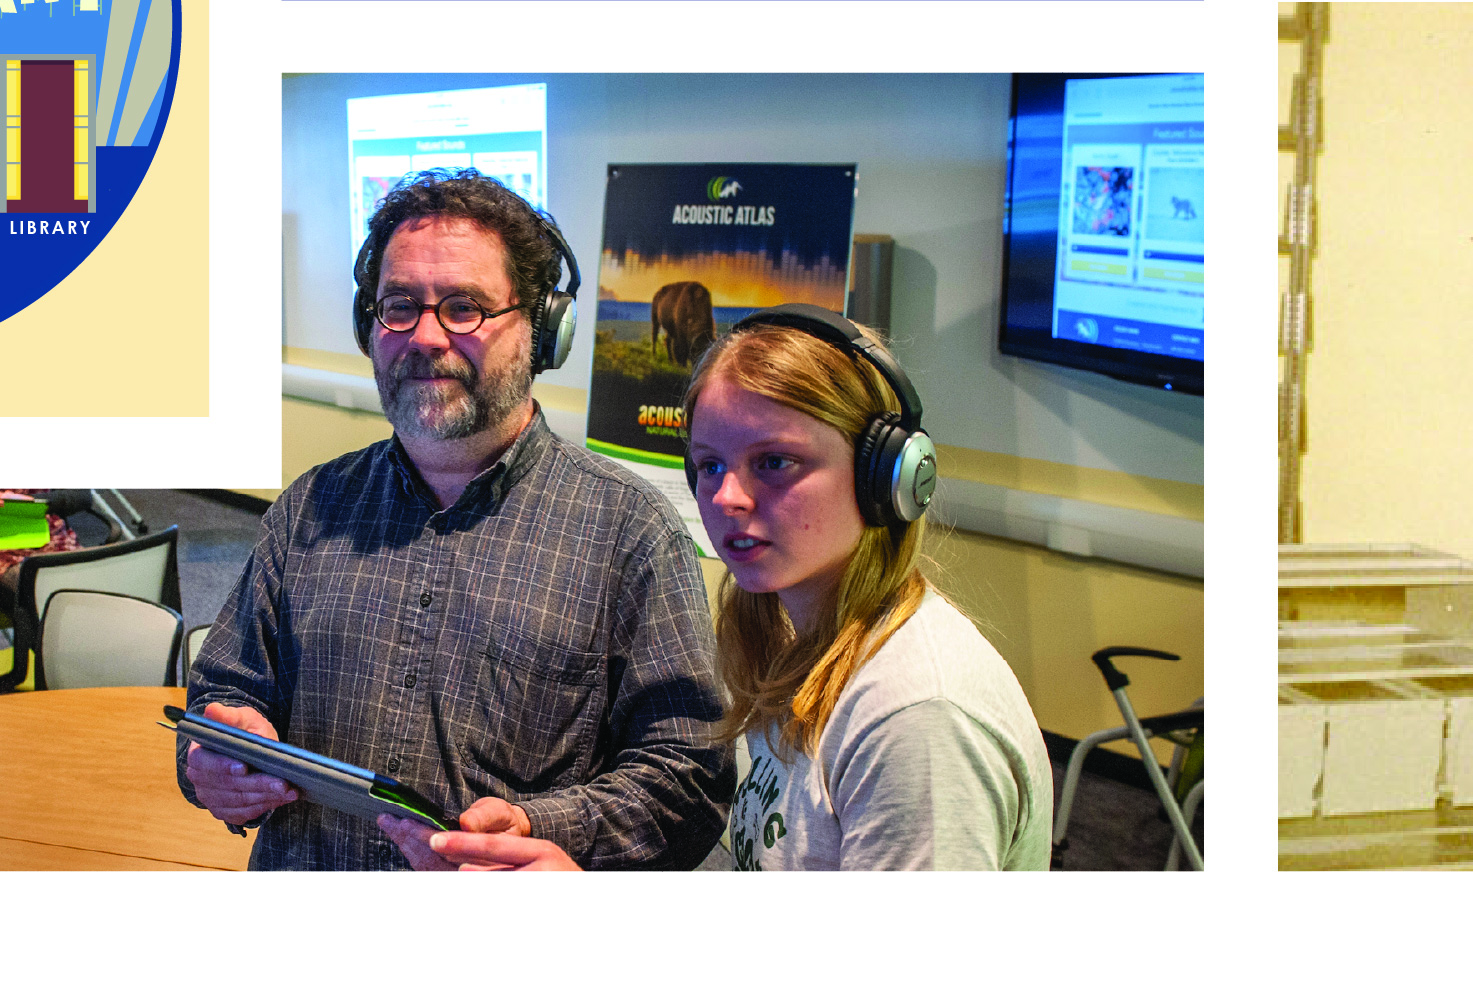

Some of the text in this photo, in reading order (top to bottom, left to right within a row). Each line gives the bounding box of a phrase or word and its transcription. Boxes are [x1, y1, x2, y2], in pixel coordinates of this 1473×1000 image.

[672, 204, 776, 226] ACOUSTIC ATLAS
[10, 221, 91, 235] LIBRARY
